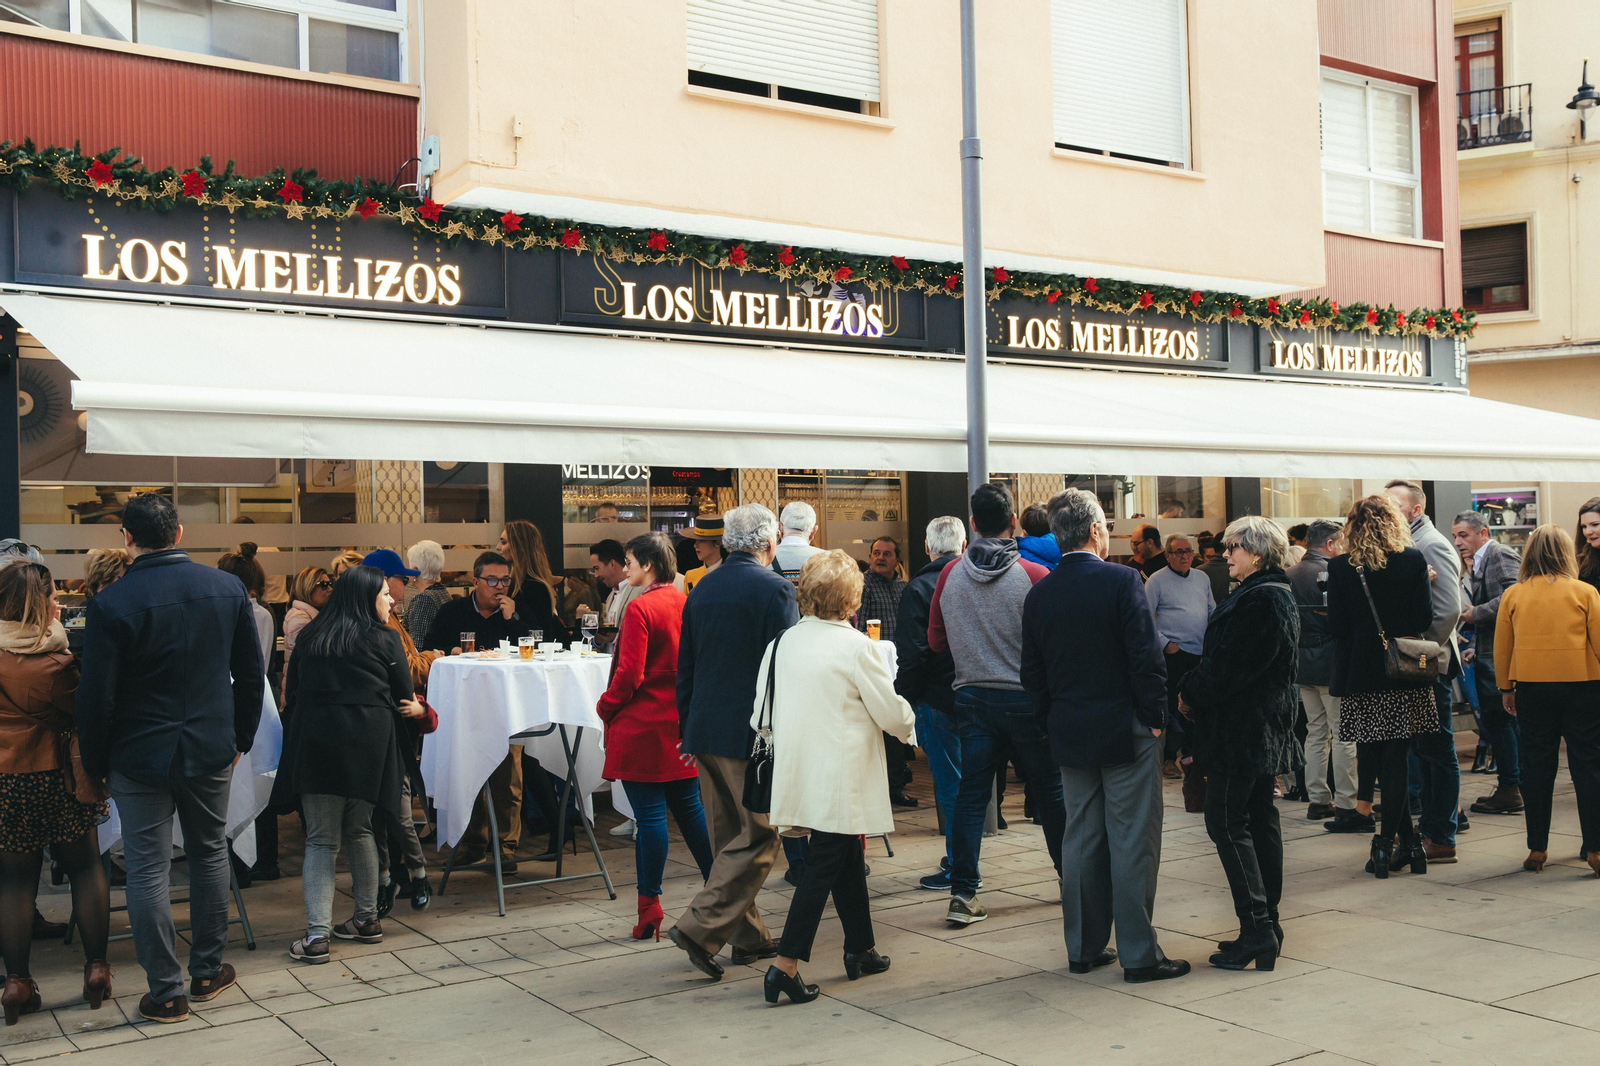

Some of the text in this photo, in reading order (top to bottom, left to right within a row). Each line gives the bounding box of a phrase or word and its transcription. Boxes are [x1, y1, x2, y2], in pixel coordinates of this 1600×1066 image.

[82, 234, 462, 306] LOS MELLIZOS
[621, 282, 884, 338] LOS MELLIZOS
[1007, 315, 1199, 361] LOS MELLIZOS
[1273, 340, 1424, 378] LOS MELLIZOS
[562, 464, 651, 480] MELLIZOS
